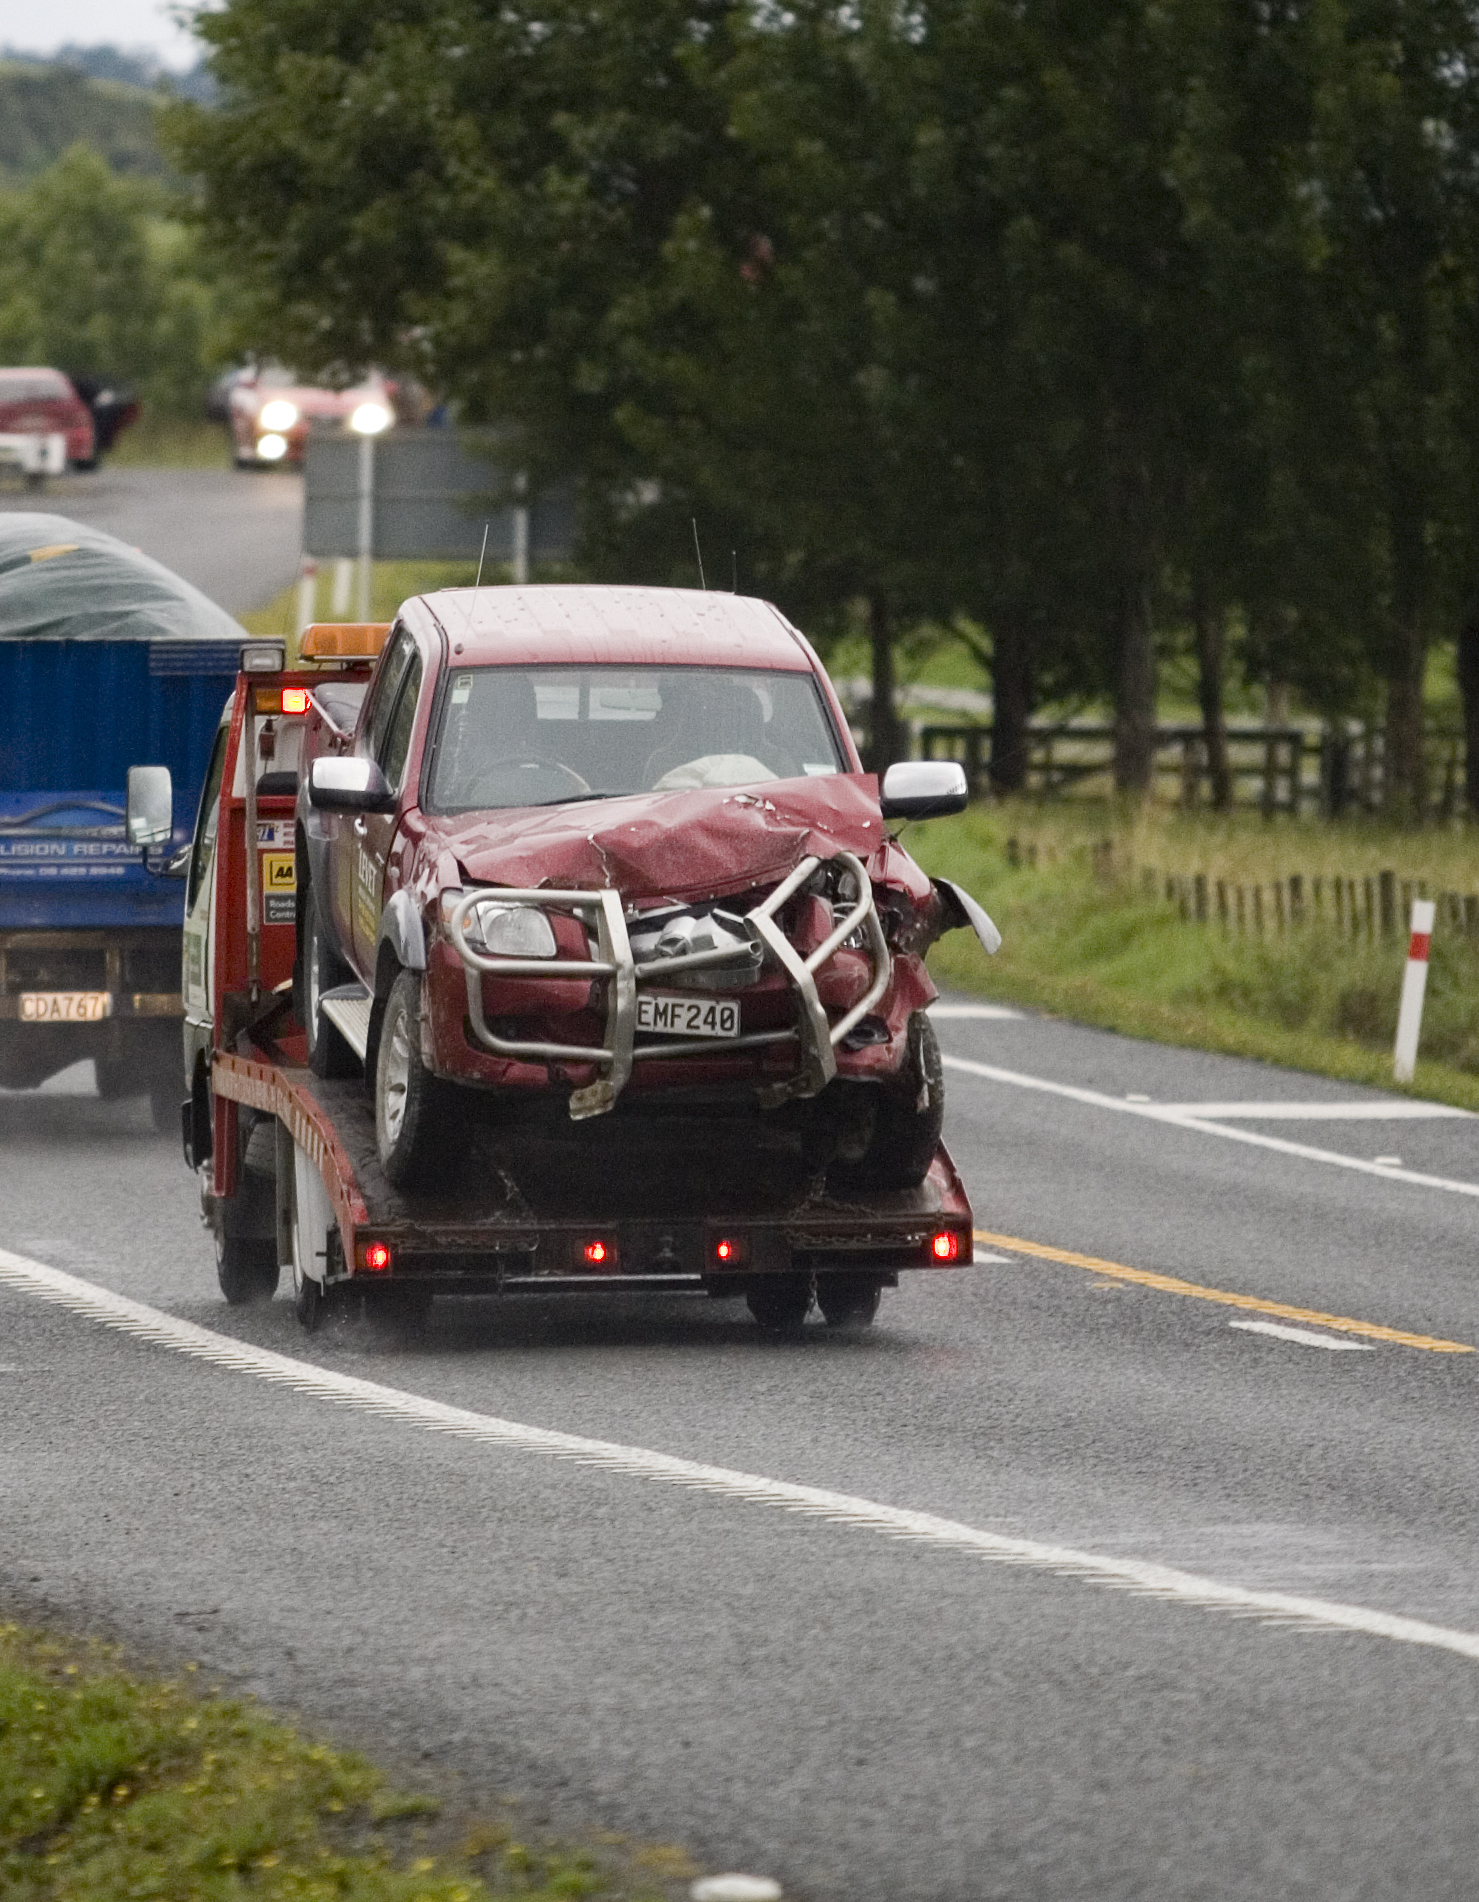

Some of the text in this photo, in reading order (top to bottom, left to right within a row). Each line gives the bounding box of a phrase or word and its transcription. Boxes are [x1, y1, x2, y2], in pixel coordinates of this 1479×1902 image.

[275, 865, 294, 879] AA
[22, 996, 100, 1019] CDA767
[637, 1000, 736, 1032] EMF240
